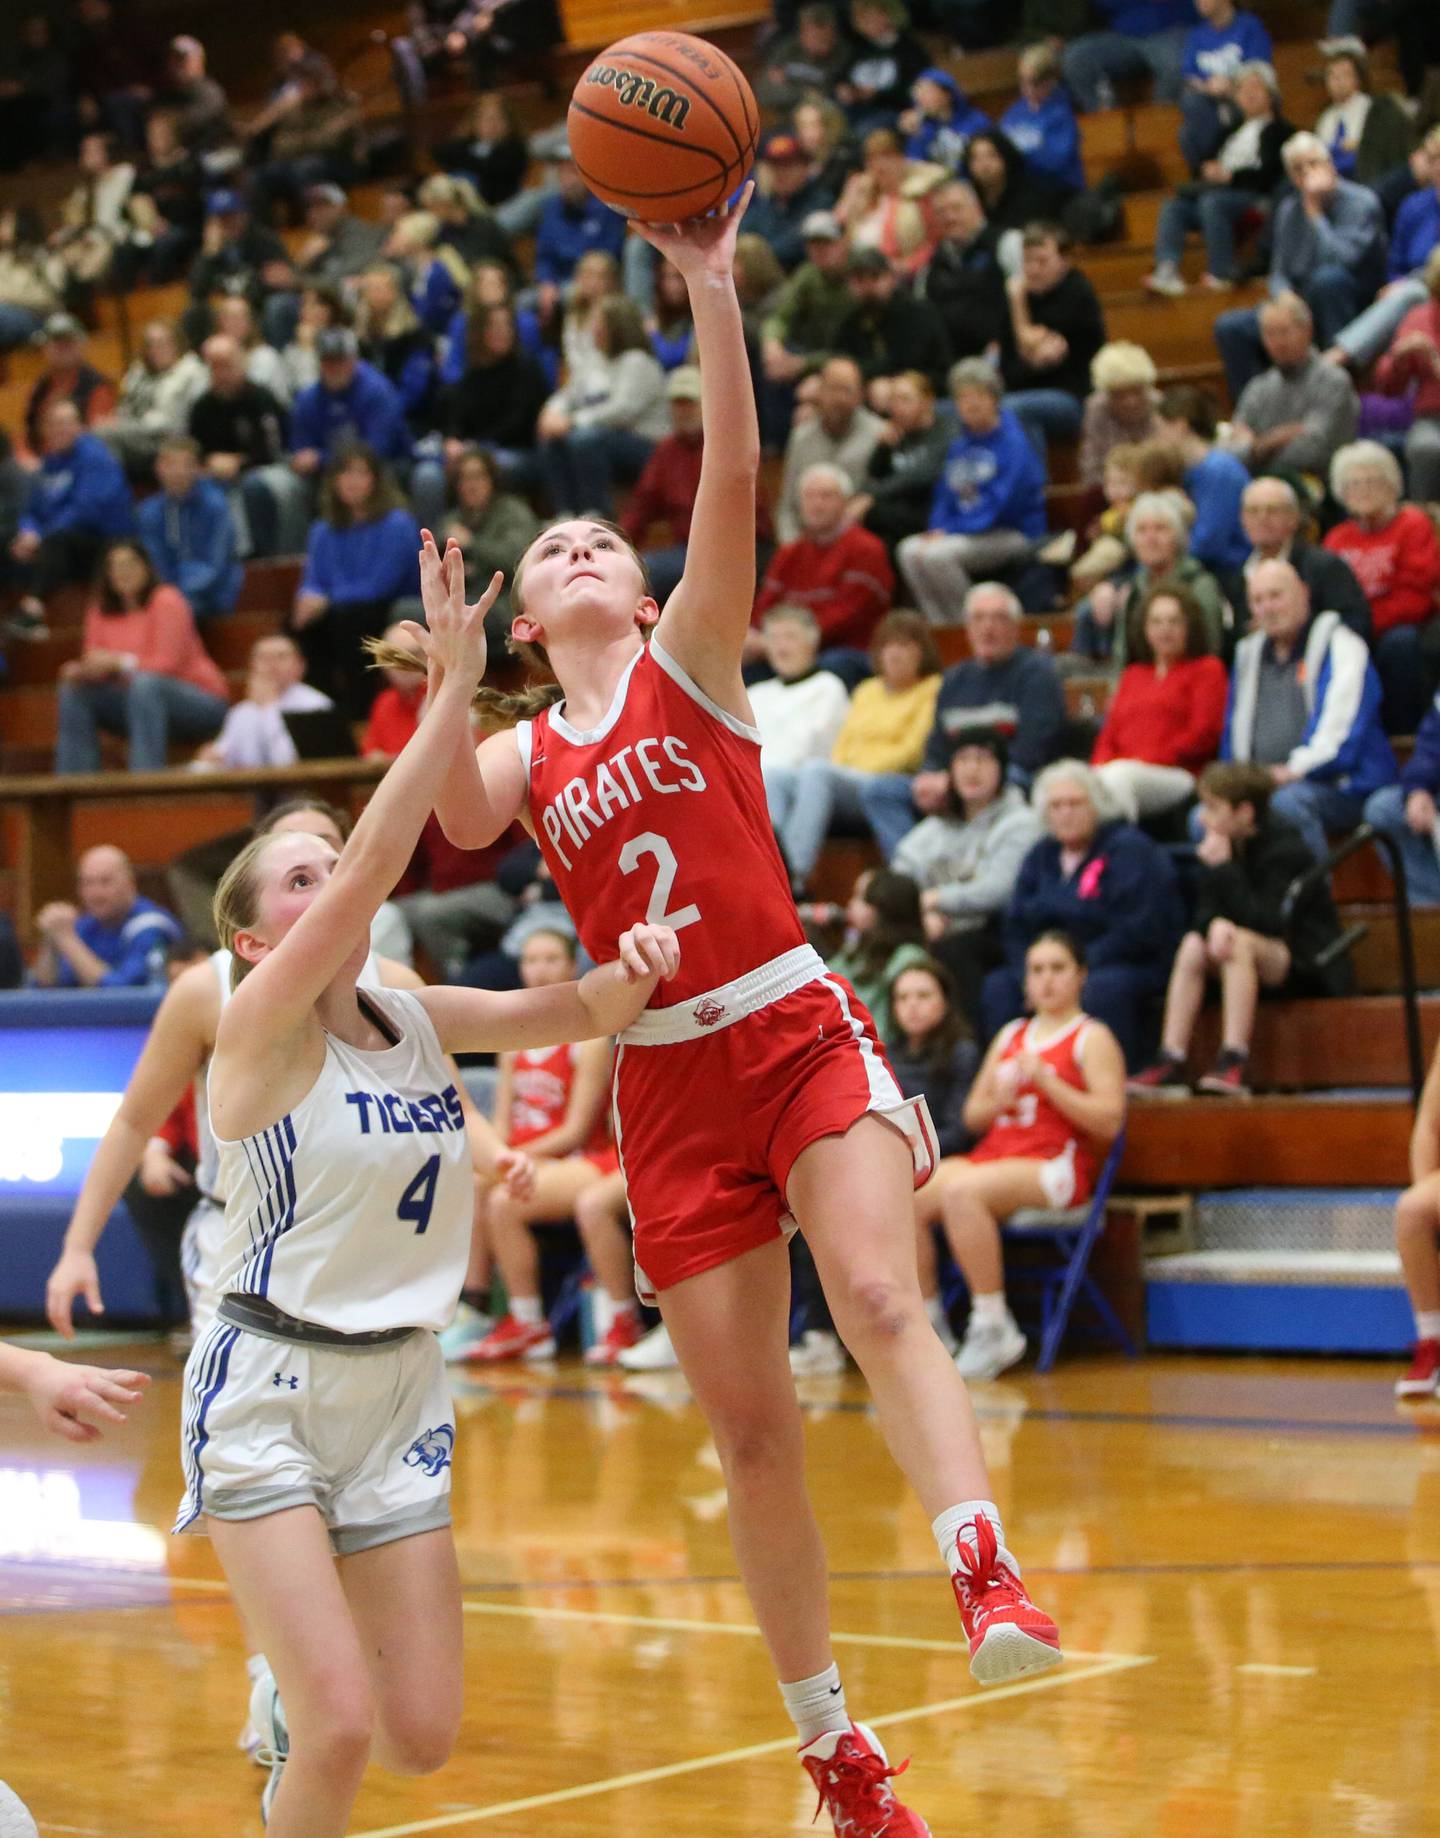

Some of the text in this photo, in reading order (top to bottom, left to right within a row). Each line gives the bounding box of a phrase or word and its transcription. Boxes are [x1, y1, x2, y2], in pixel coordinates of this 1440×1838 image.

[586, 64, 690, 131] Wilson
[541, 735, 708, 872] PIRATES
[617, 831, 702, 932] 2
[345, 1083, 466, 1134] TIGERS
[396, 1153, 441, 1235] 4
